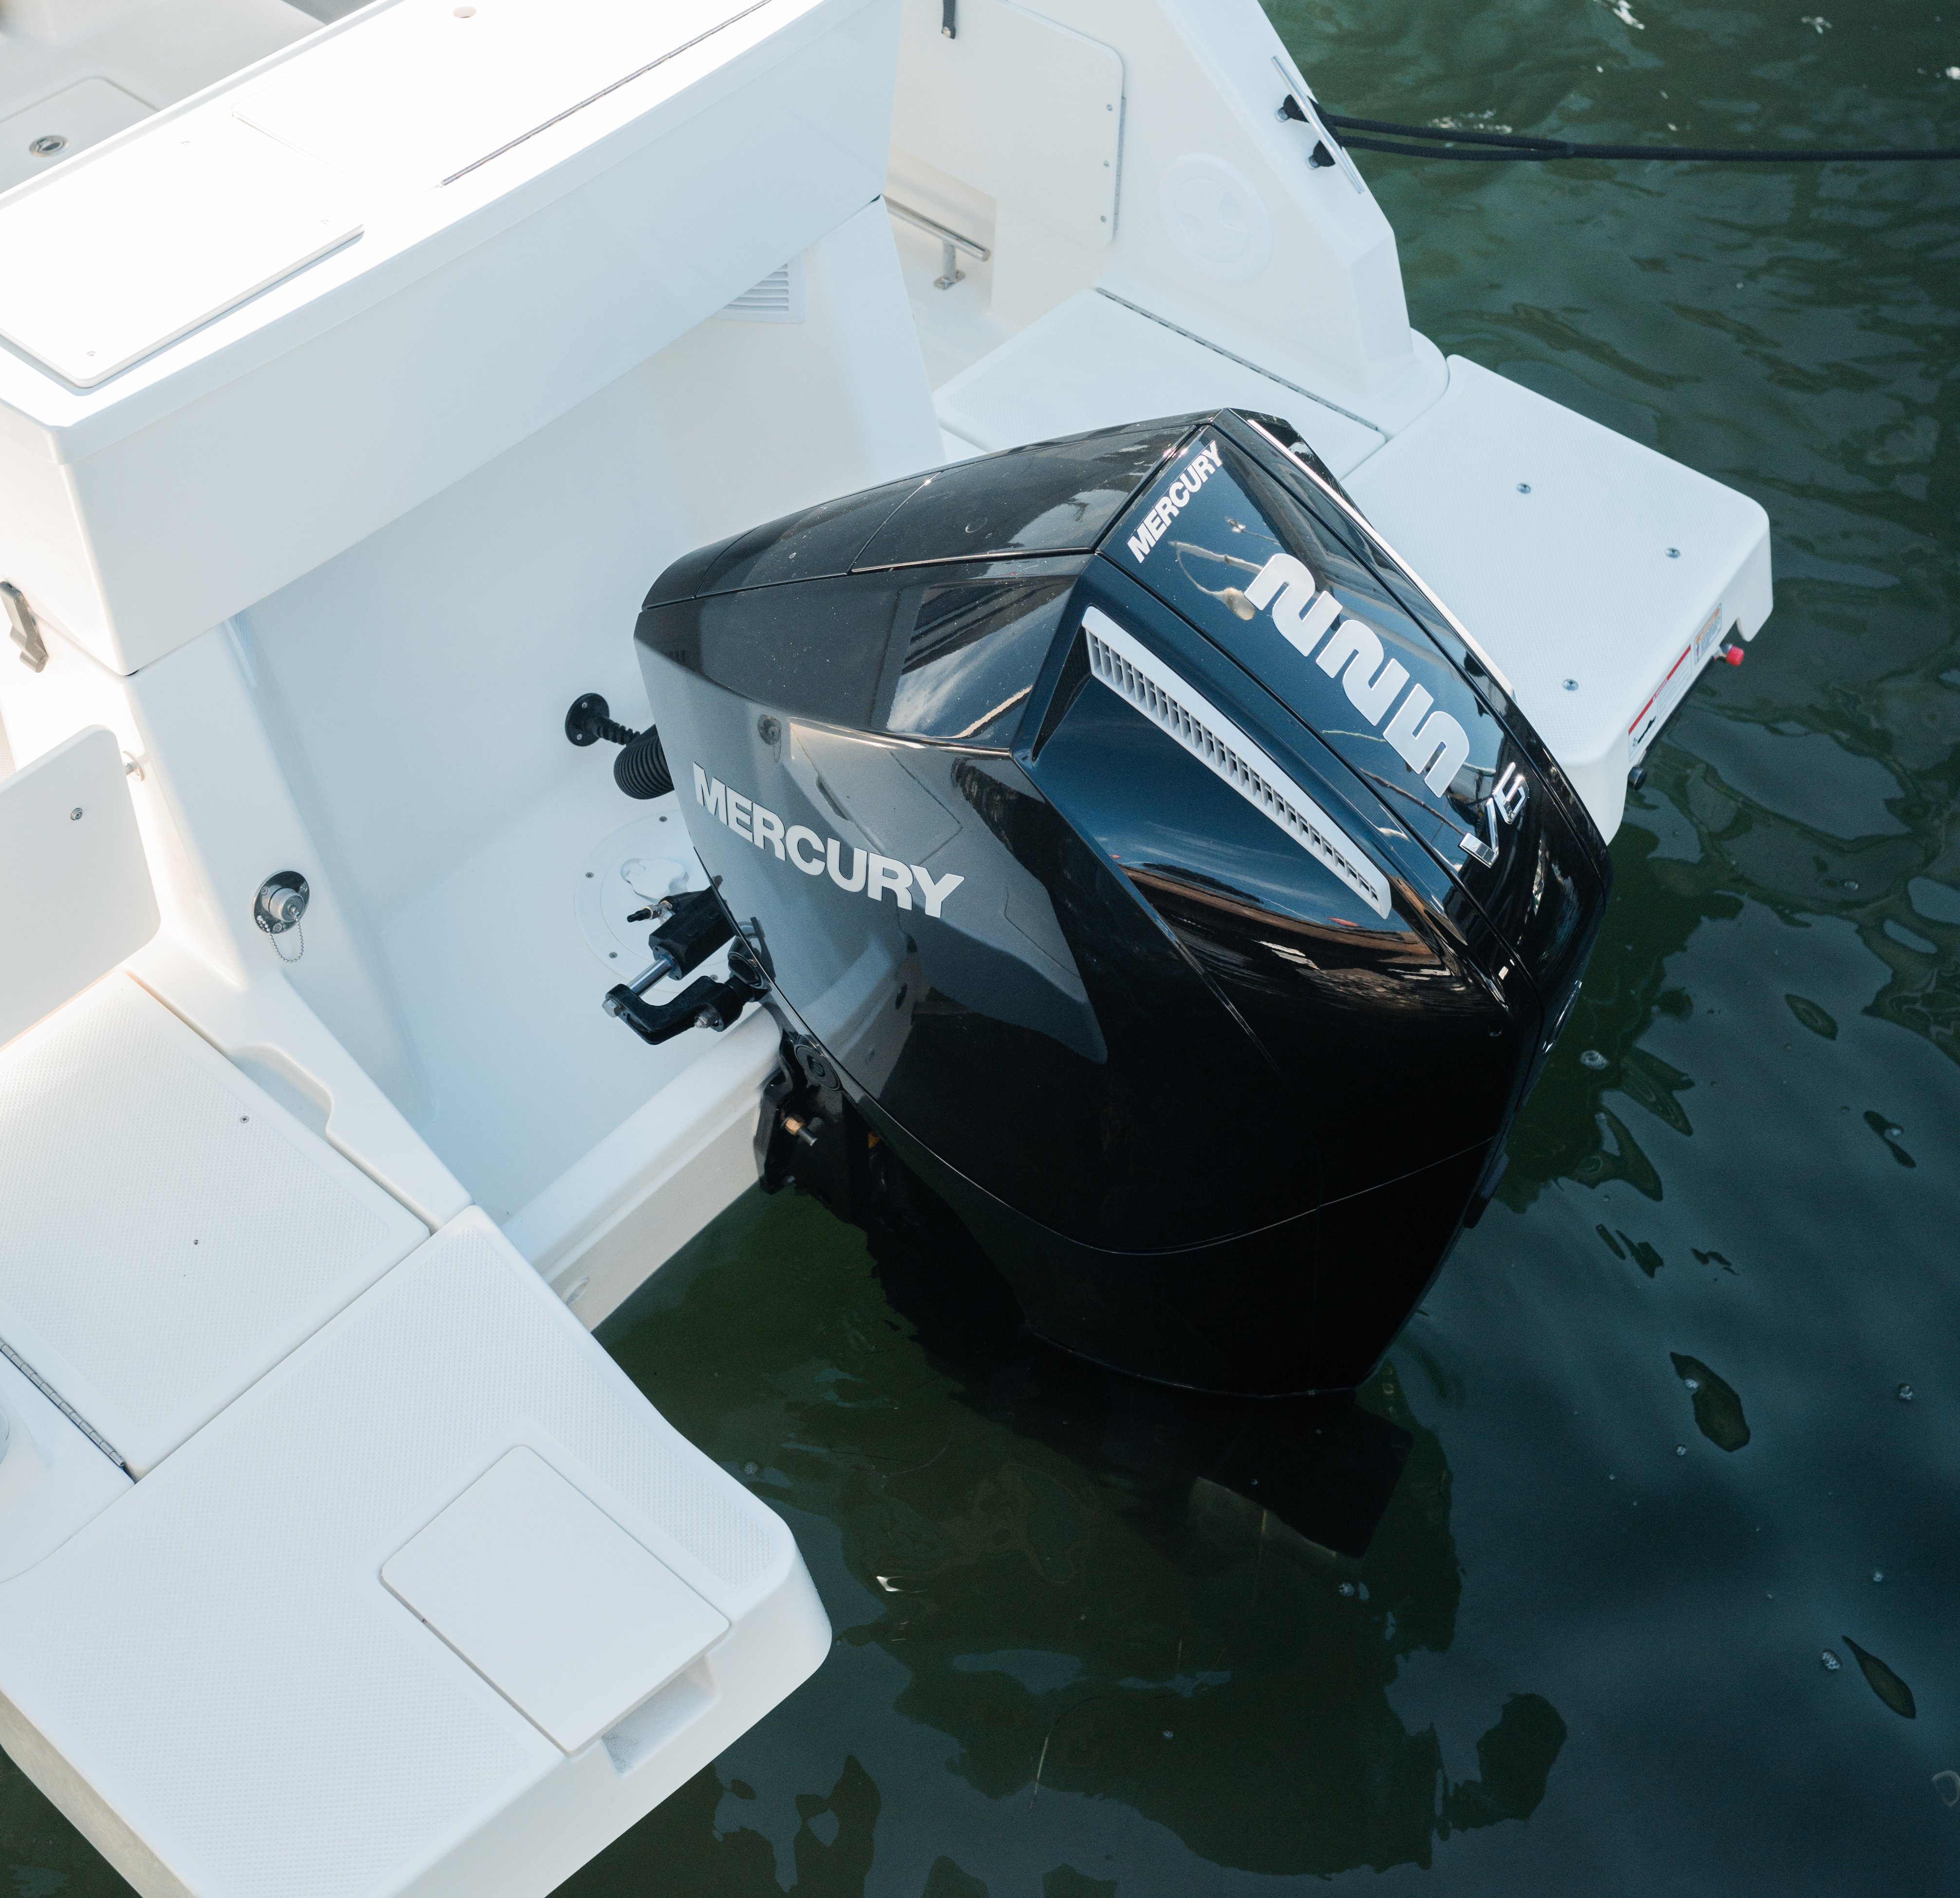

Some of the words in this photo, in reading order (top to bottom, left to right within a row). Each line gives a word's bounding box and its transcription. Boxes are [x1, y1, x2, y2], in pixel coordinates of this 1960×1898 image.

[1127, 440, 1223, 563] MERCURY
[1244, 553, 1469, 797] 225
[693, 761, 964, 918] MERCURY
[1458, 762, 1529, 868] V6
